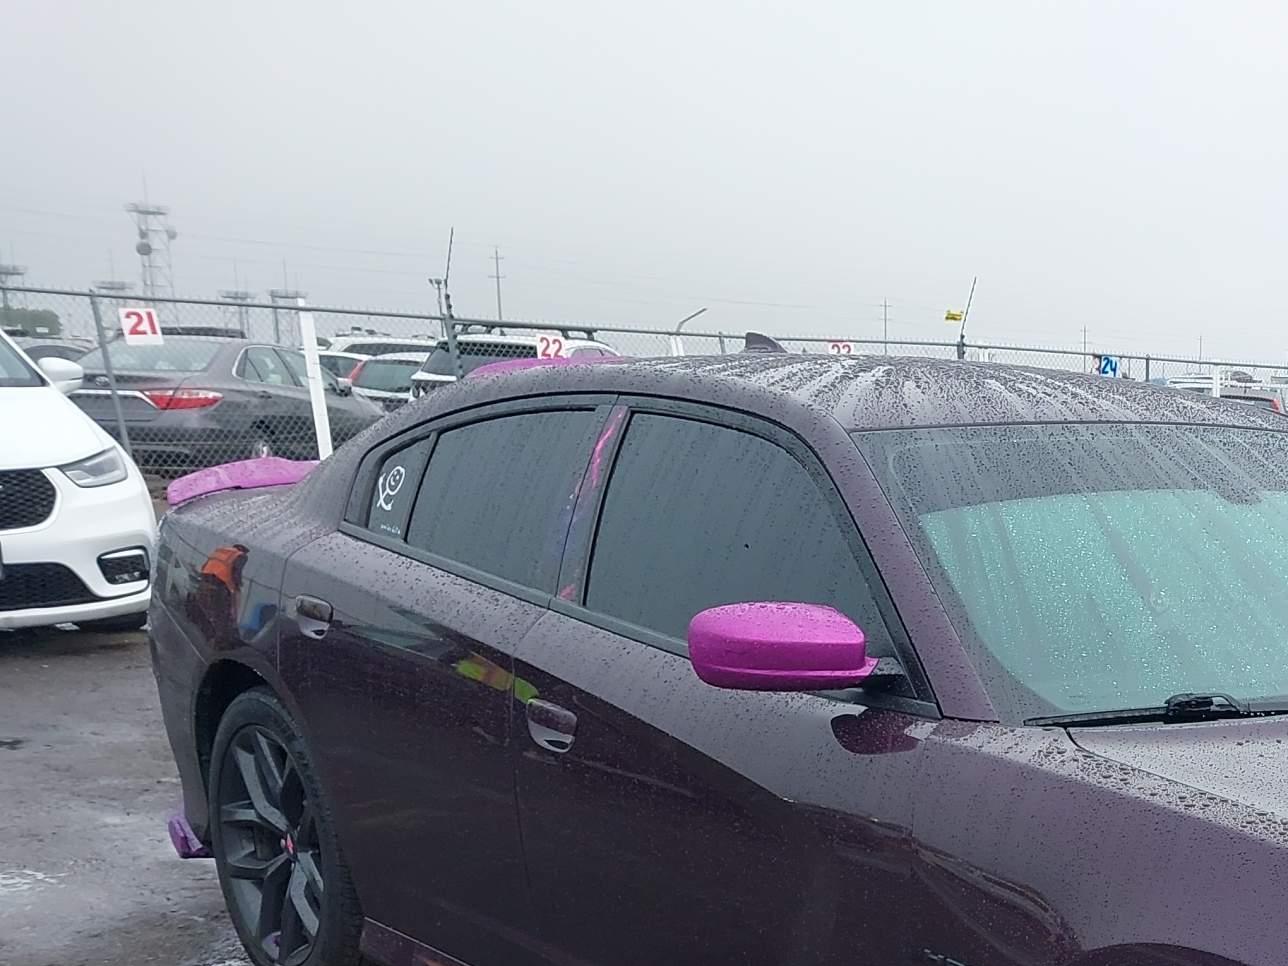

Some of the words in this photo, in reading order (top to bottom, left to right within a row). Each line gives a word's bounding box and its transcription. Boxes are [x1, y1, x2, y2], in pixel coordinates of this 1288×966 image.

[124, 311, 158, 335] 21
[540, 336, 566, 358] 22
[1102, 357, 1118, 378] 24
